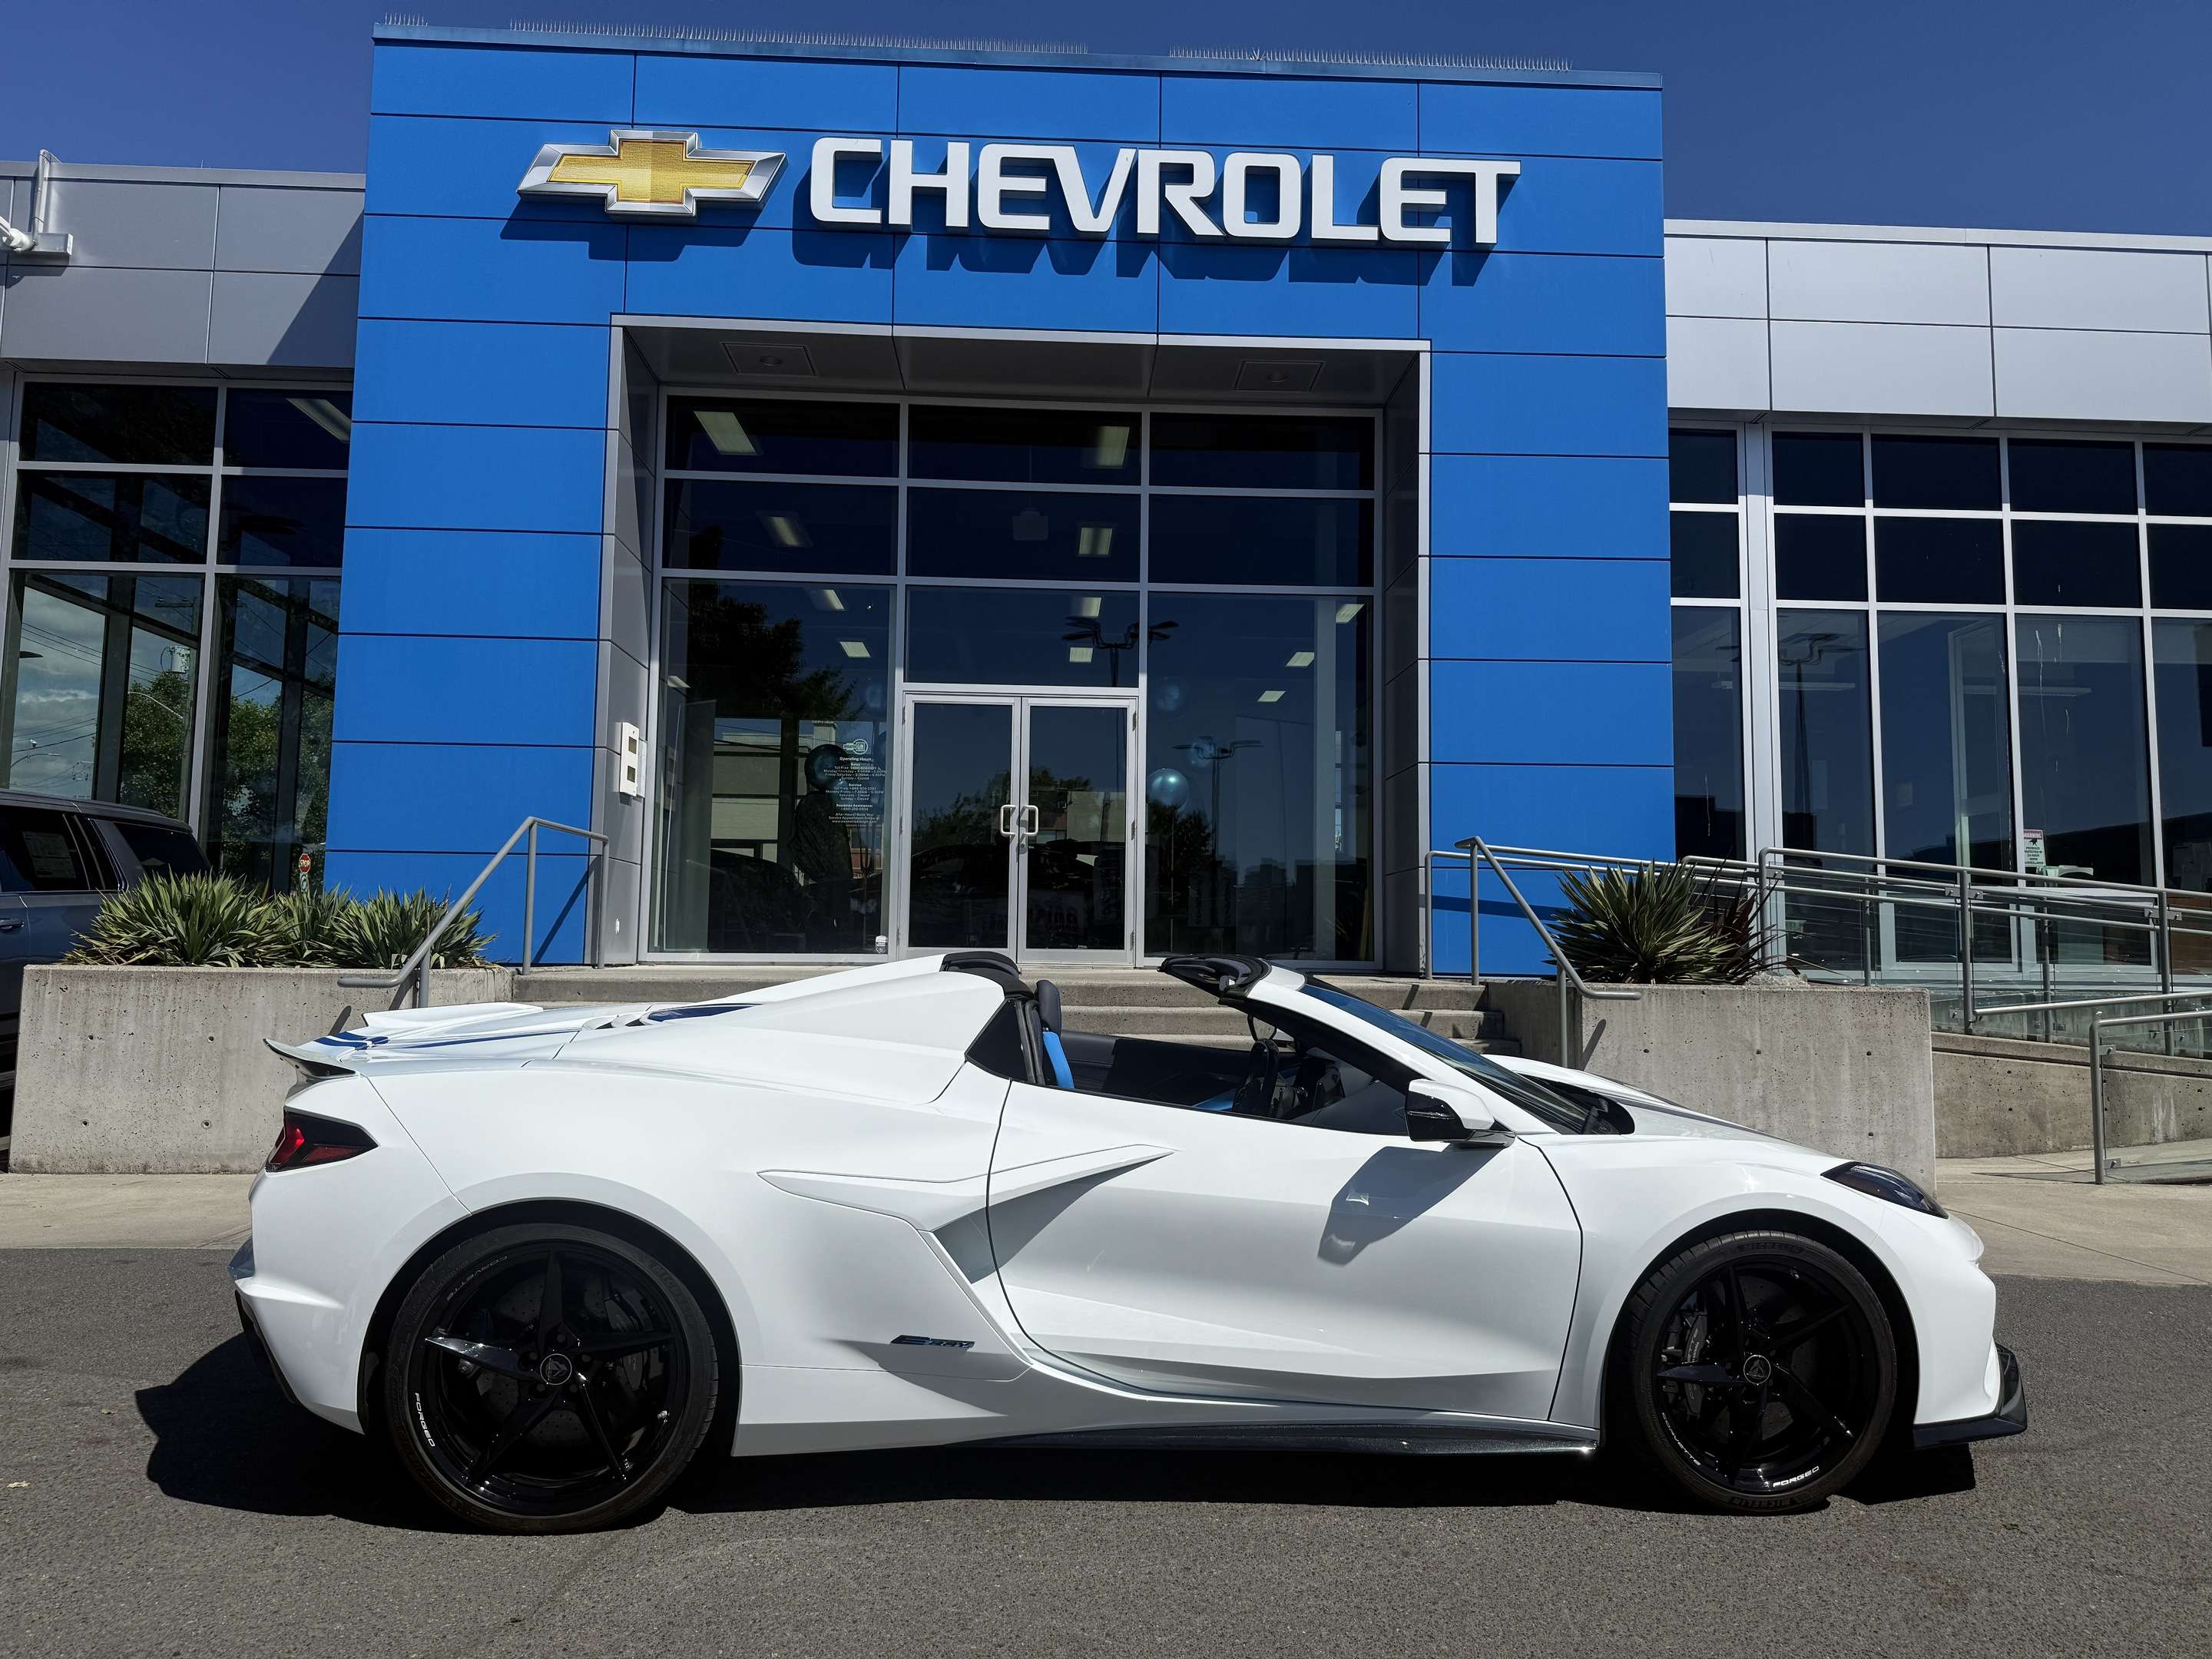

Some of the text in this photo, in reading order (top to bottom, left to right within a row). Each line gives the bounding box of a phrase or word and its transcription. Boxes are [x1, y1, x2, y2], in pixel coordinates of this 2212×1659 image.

[810, 137, 1522, 244] CHEVROLET
[446, 1256, 508, 1302] CORVETTE
[415, 1392, 435, 1447] FORGED
[1661, 1412, 1701, 1466] CORVETTE
[1773, 1465, 1820, 1488] FORGED
